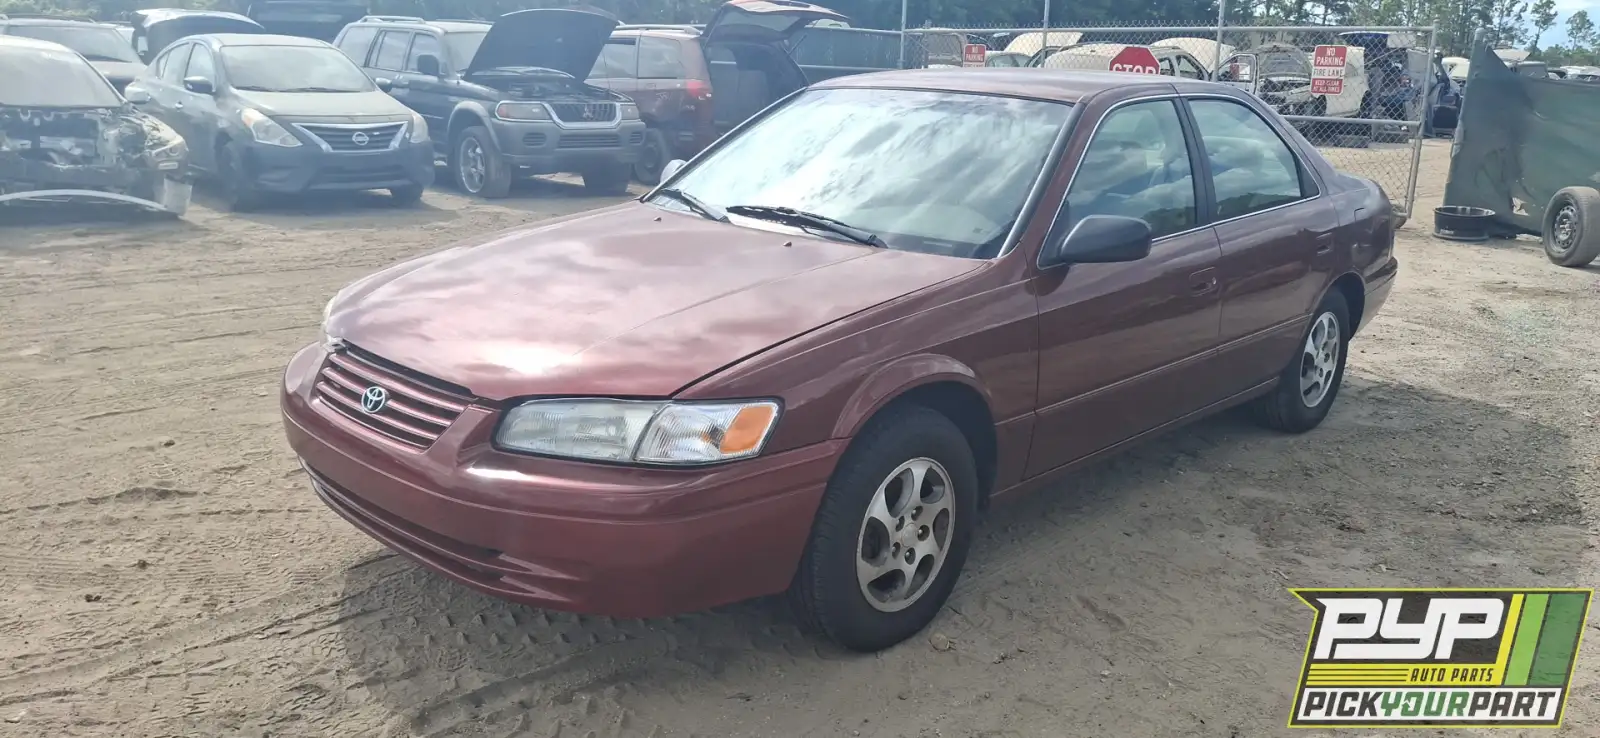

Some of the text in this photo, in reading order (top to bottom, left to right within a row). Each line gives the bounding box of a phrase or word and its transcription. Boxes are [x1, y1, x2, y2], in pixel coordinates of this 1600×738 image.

[1326, 48, 1336, 56] NO
[1316, 56, 1343, 65] PARKING
[1328, 69, 1343, 77] LANE
